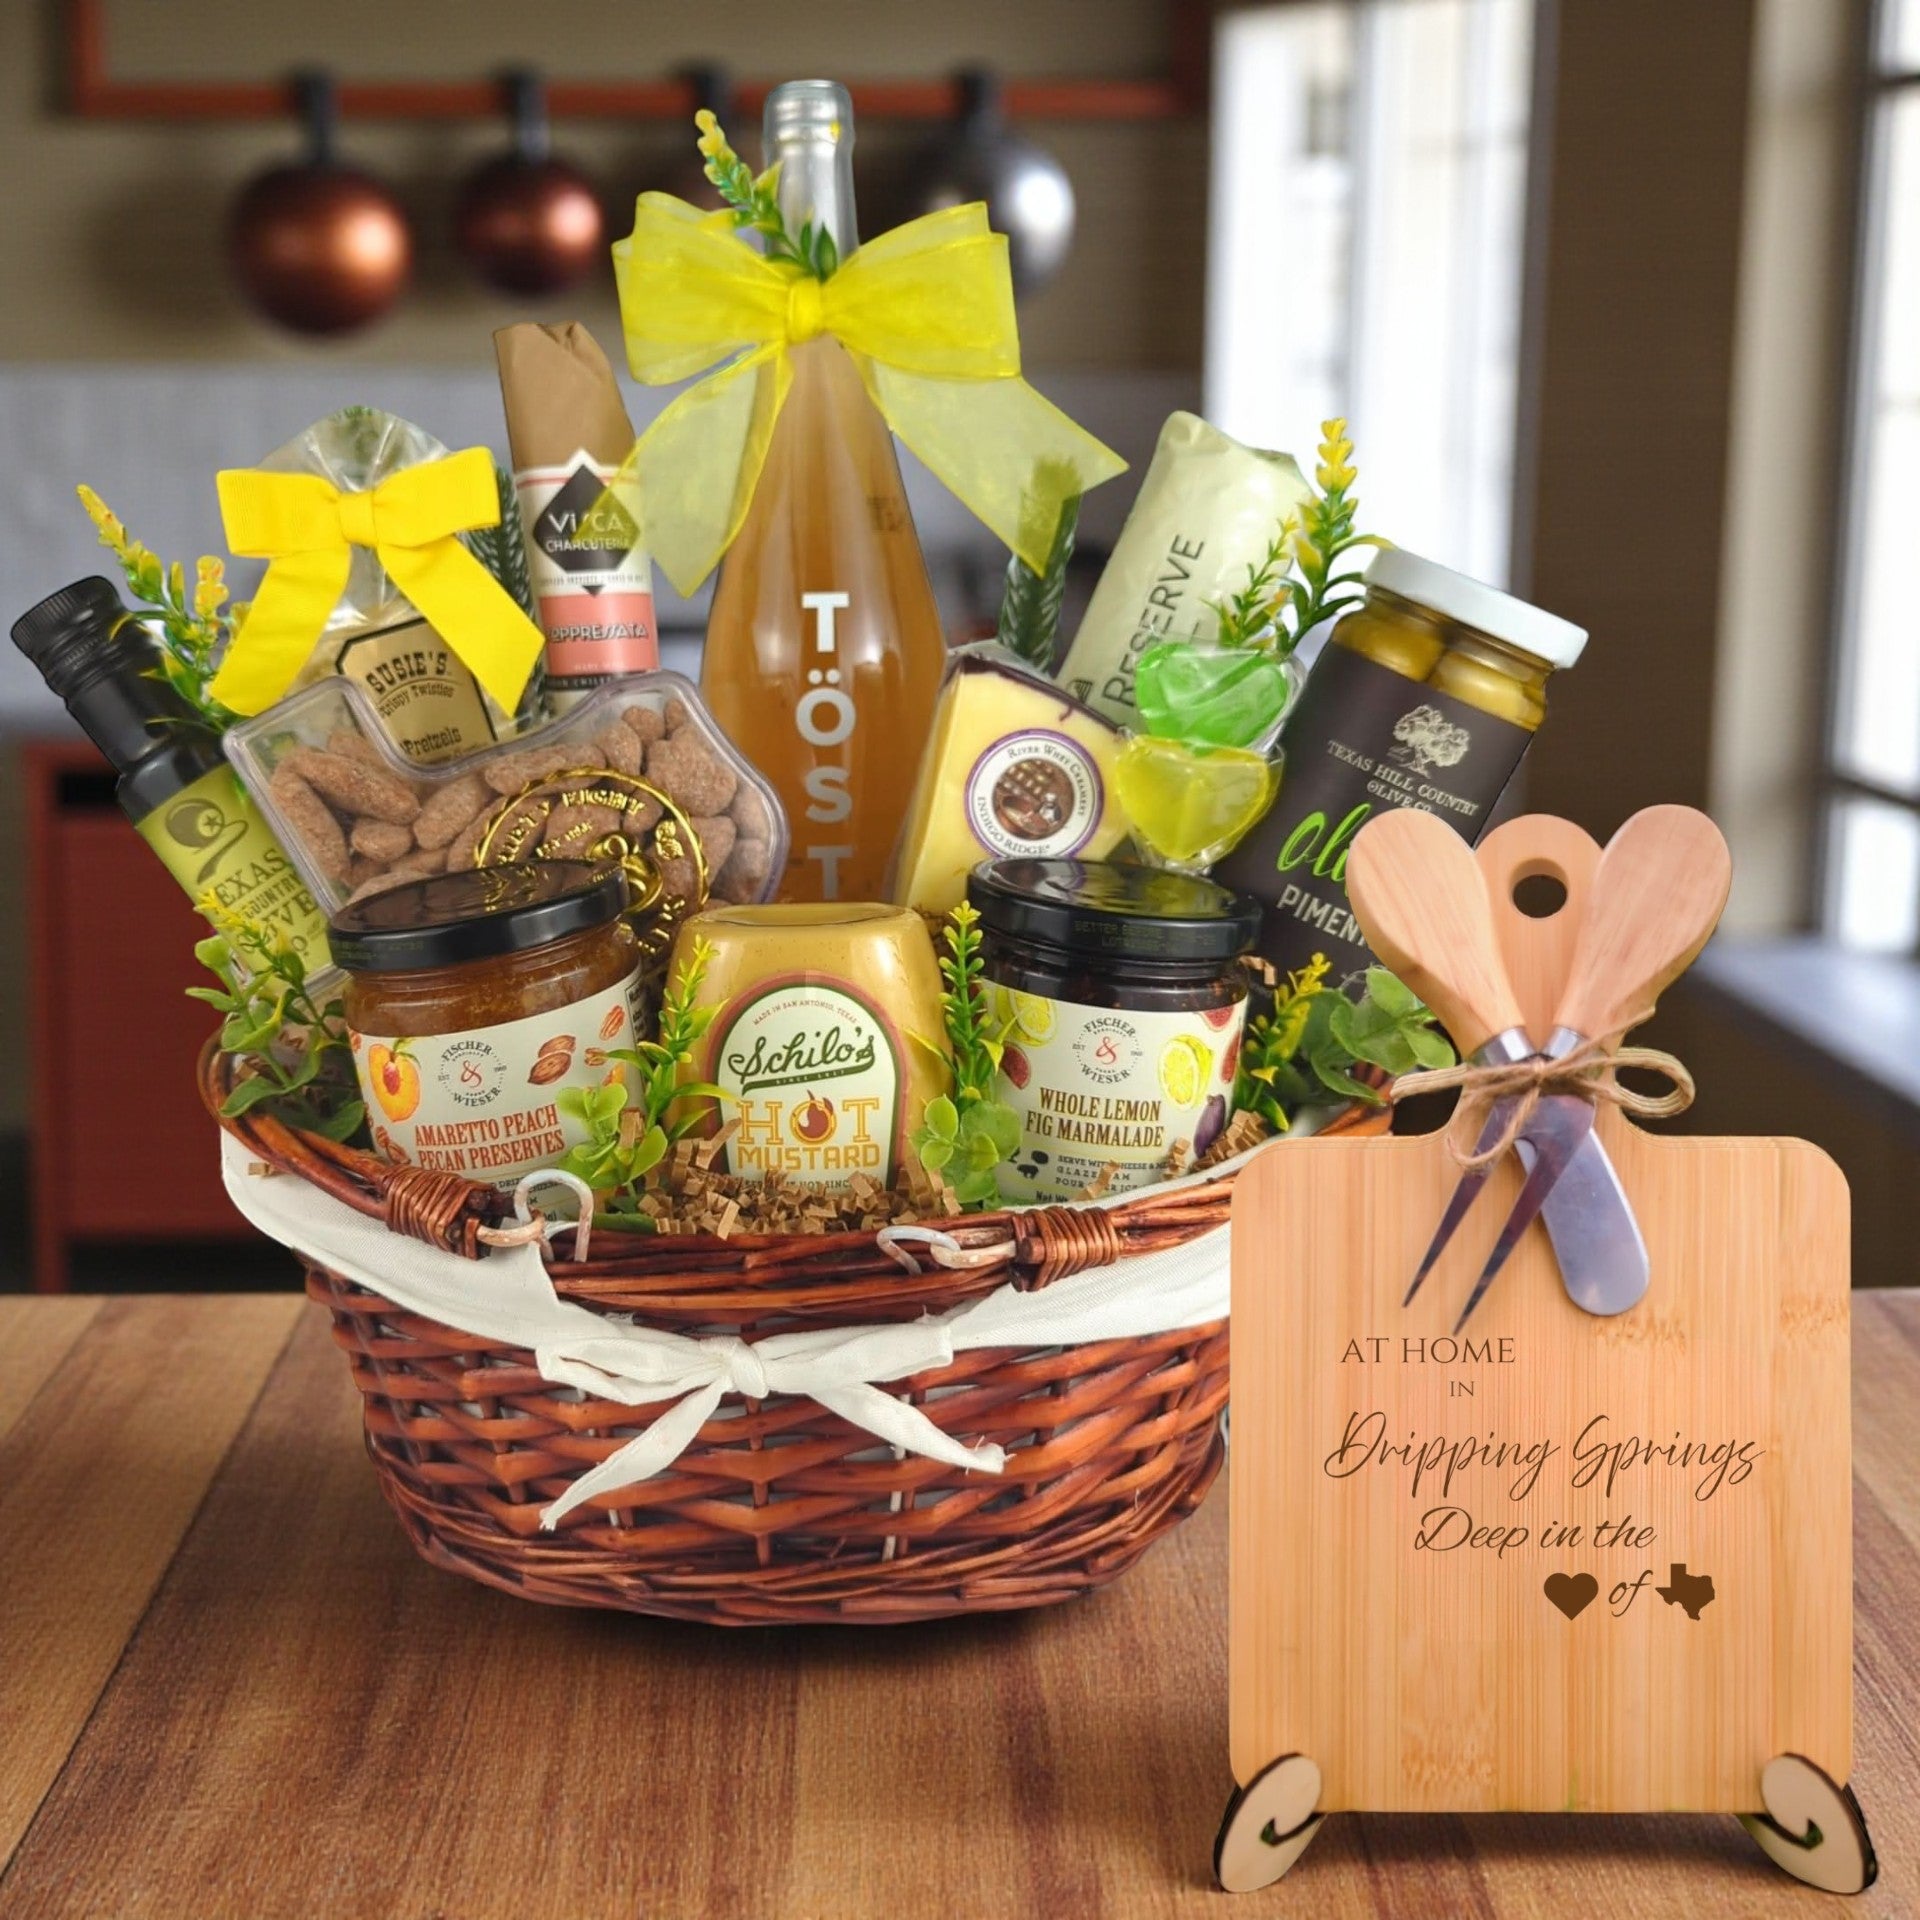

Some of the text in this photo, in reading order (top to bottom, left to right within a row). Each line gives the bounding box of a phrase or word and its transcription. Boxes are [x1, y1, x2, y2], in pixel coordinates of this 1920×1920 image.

[1102, 534, 1205, 708] RESERVE
[366, 650, 447, 695] SUSIE'S
[401, 726, 462, 755] Pretzels
[795, 591, 857, 900] TÖST
[1327, 739, 1480, 817] TEXAS HILL COUNTRY
[214, 848, 286, 909] EXAS
[1083, 1016, 1136, 1038] FISCHER
[441, 1040, 493, 1062] FISCHER
[728, 1026, 876, 1085] Schilo's
[1080, 1064, 1131, 1085] WIESER
[453, 1086, 502, 1108] WIESER
[1040, 1087, 1162, 1122] WHOLE LEMON
[414, 1104, 560, 1147] AMARETTO PEACH
[737, 1097, 881, 1146] HOT
[1025, 1111, 1165, 1147] FIG MARMALADE
[418, 1129, 565, 1172] PECAN PRESERVES
[737, 1144, 880, 1171] MUSTARD
[1088, 1159, 1108, 1169] WIT
[1341, 1337, 1516, 1365] AT HOME
[1450, 1381, 1474, 1397] IN
[1324, 1411, 1767, 1501] Dripping Springs
[1414, 1506, 1657, 1559] Deep in the
[1608, 1569, 1653, 1617] of
